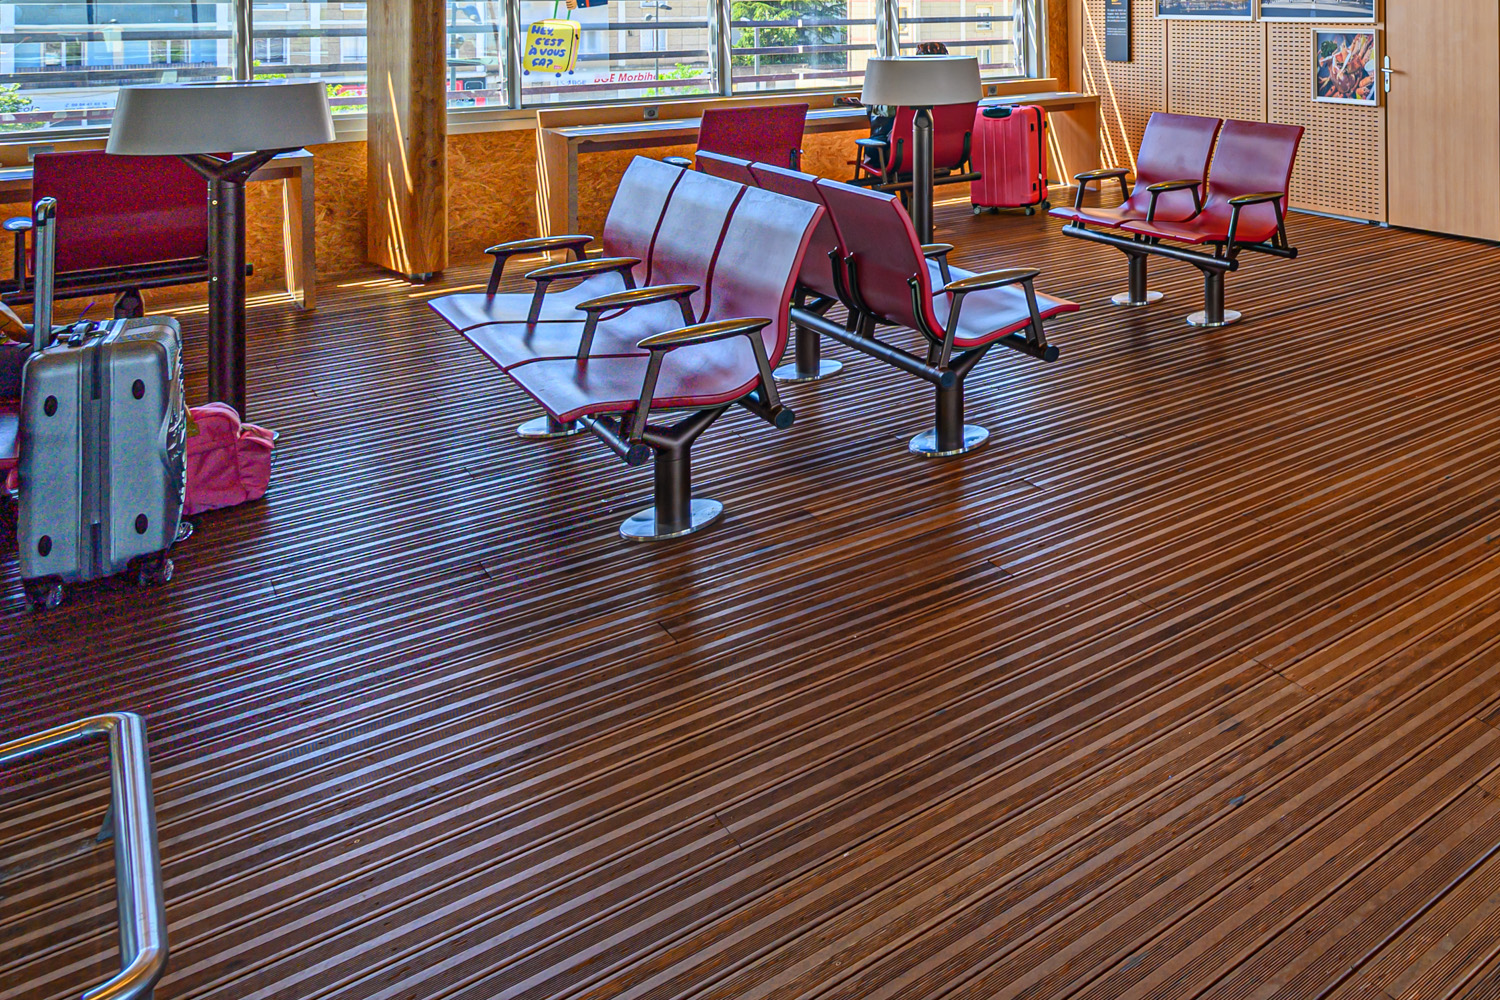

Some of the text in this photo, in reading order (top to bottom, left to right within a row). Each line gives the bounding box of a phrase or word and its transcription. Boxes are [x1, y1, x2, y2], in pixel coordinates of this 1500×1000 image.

[531, 25, 554, 36] HEY,
[535, 37, 565, 47] C'EST
[528, 45, 566, 57] À VOUS
[531, 57, 554, 68] ÇA?
[617, 72, 657, 82] Morbih
